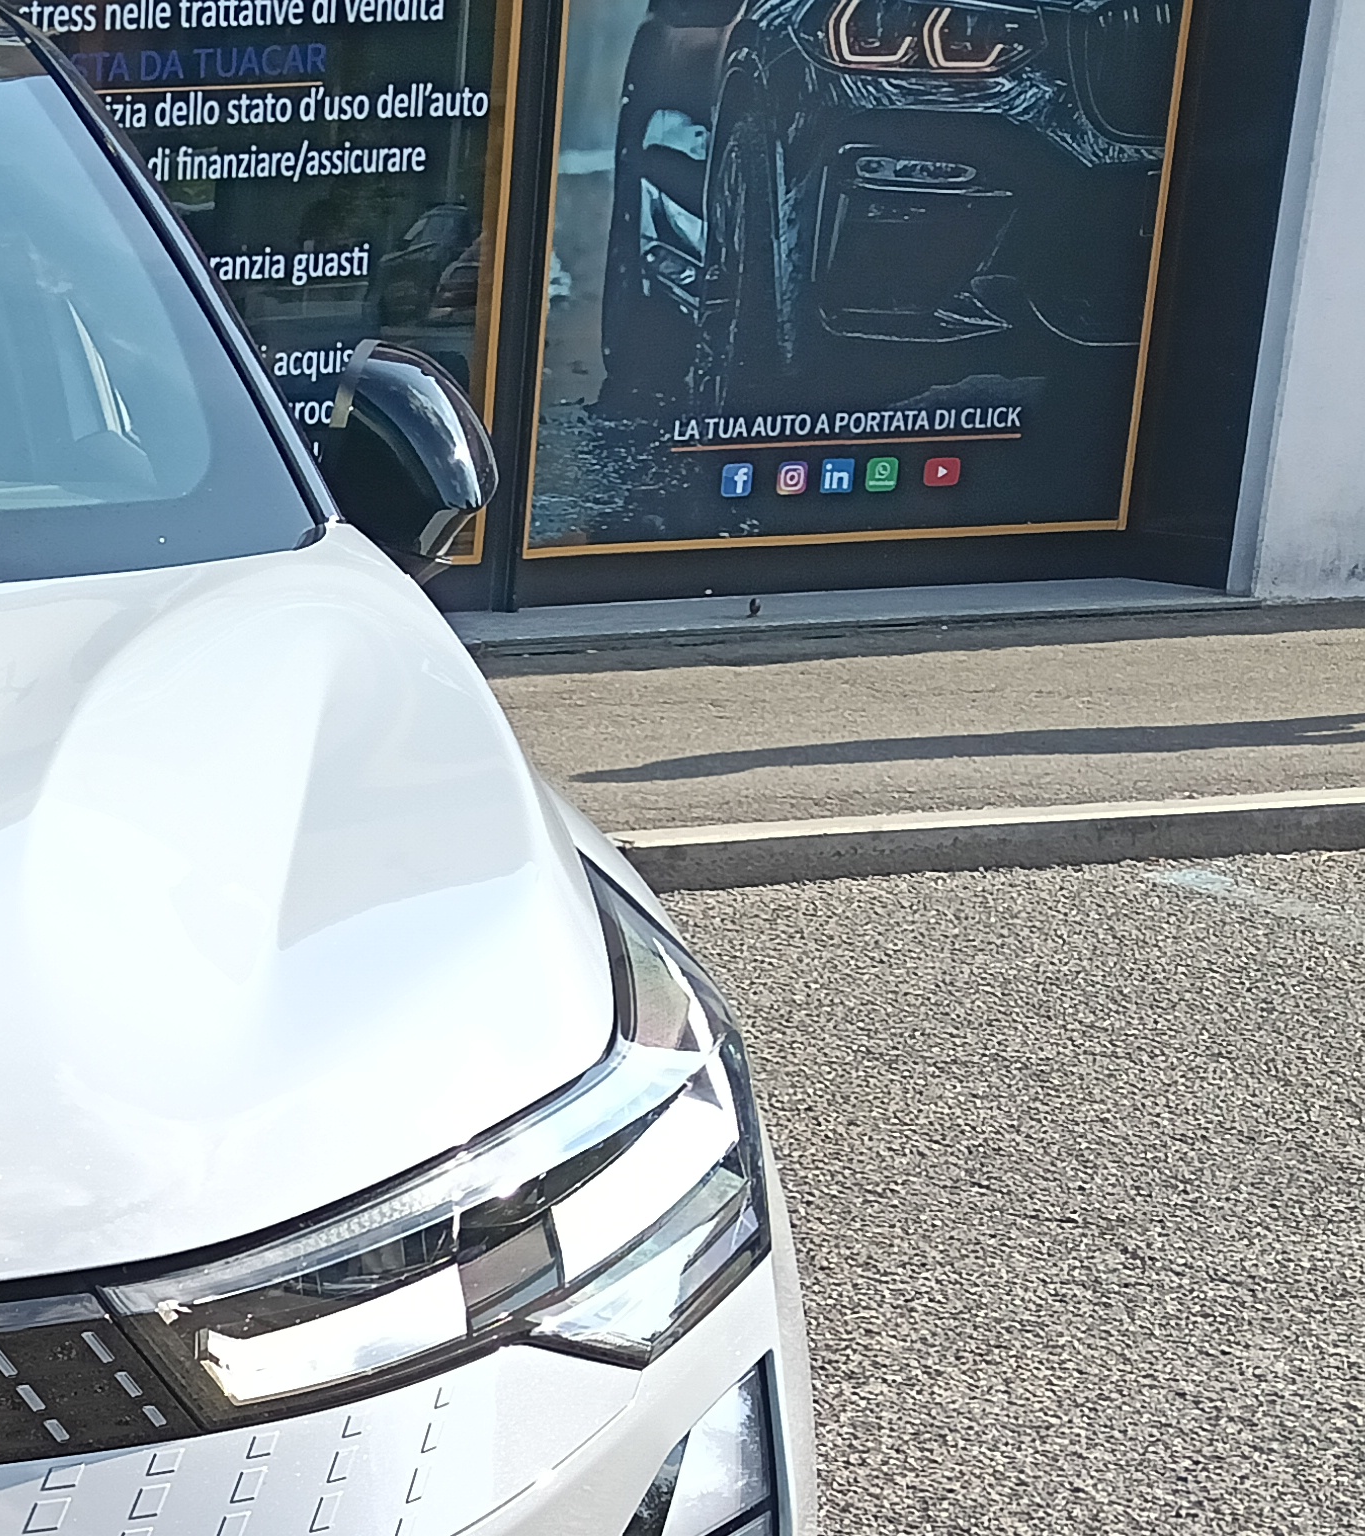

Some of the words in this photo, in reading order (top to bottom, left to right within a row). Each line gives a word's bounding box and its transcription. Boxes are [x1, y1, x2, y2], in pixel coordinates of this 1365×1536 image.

[105, 0, 172, 31] nelle
[179, 0, 305, 29] trattative
[312, 0, 336, 25] di
[345, 0, 445, 23] vendita
[140, 49, 184, 81] DA
[193, 43, 327, 79] TUACAR
[154, 91, 220, 128] dello
[227, 93, 293, 125] stato
[299, 86, 370, 122] d'uso
[377, 82, 489, 119] dell'auto
[147, 146, 171, 182] di
[177, 140, 426, 183] finanziare/assicurare
[292, 243, 370, 286] guasti
[673, 419, 700, 441] LA
[704, 417, 748, 440] TUA
[750, 414, 812, 437] AUTO
[814, 413, 830, 435] A
[834, 410, 930, 434] PORTATA
[934, 408, 956, 431] DI
[960, 406, 1022, 429] CLICK
